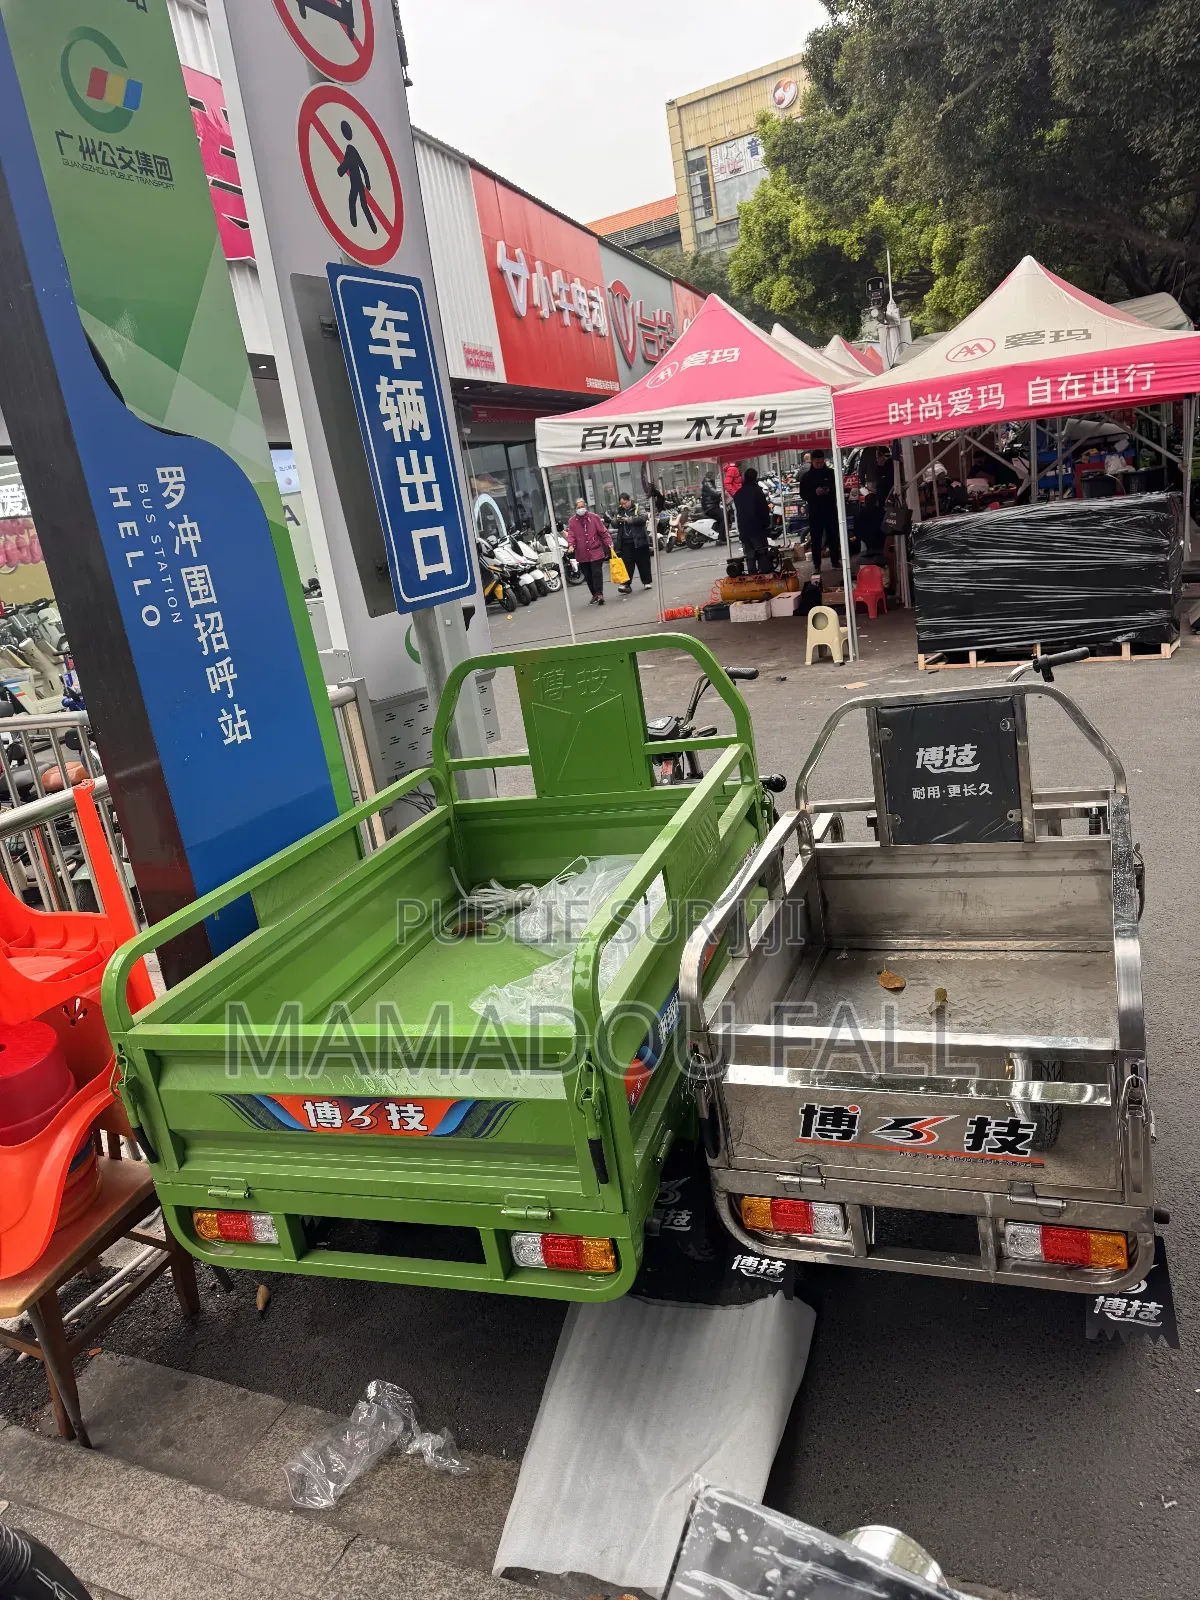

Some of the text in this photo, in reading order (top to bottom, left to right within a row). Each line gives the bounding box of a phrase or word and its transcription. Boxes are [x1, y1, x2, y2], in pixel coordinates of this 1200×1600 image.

[55, 129, 174, 182] 广州公交集团
[61, 157, 176, 191] GUANGZHOU PUBLIC TRANSPORT
[532, 260, 609, 337] 小牛电动
[680, 347, 741, 373] 爱玛
[1004, 328, 1092, 350] 爱玛
[887, 362, 1156, 427] 时尚爱玛 自在出行
[361, 300, 453, 582] 车辆出口
[580, 420, 664, 453] 百公里
[684, 408, 778, 442] 不充电
[108, 485, 162, 627] HELLO
[137, 482, 183, 624] BUS STATION
[155, 465, 252, 746] 罗冲围招呼站
[533, 667, 617, 701] 博技
[915, 743, 979, 769] 博技
[731, 1254, 787, 1279] 博技
[1093, 1295, 1164, 1321] 博技
